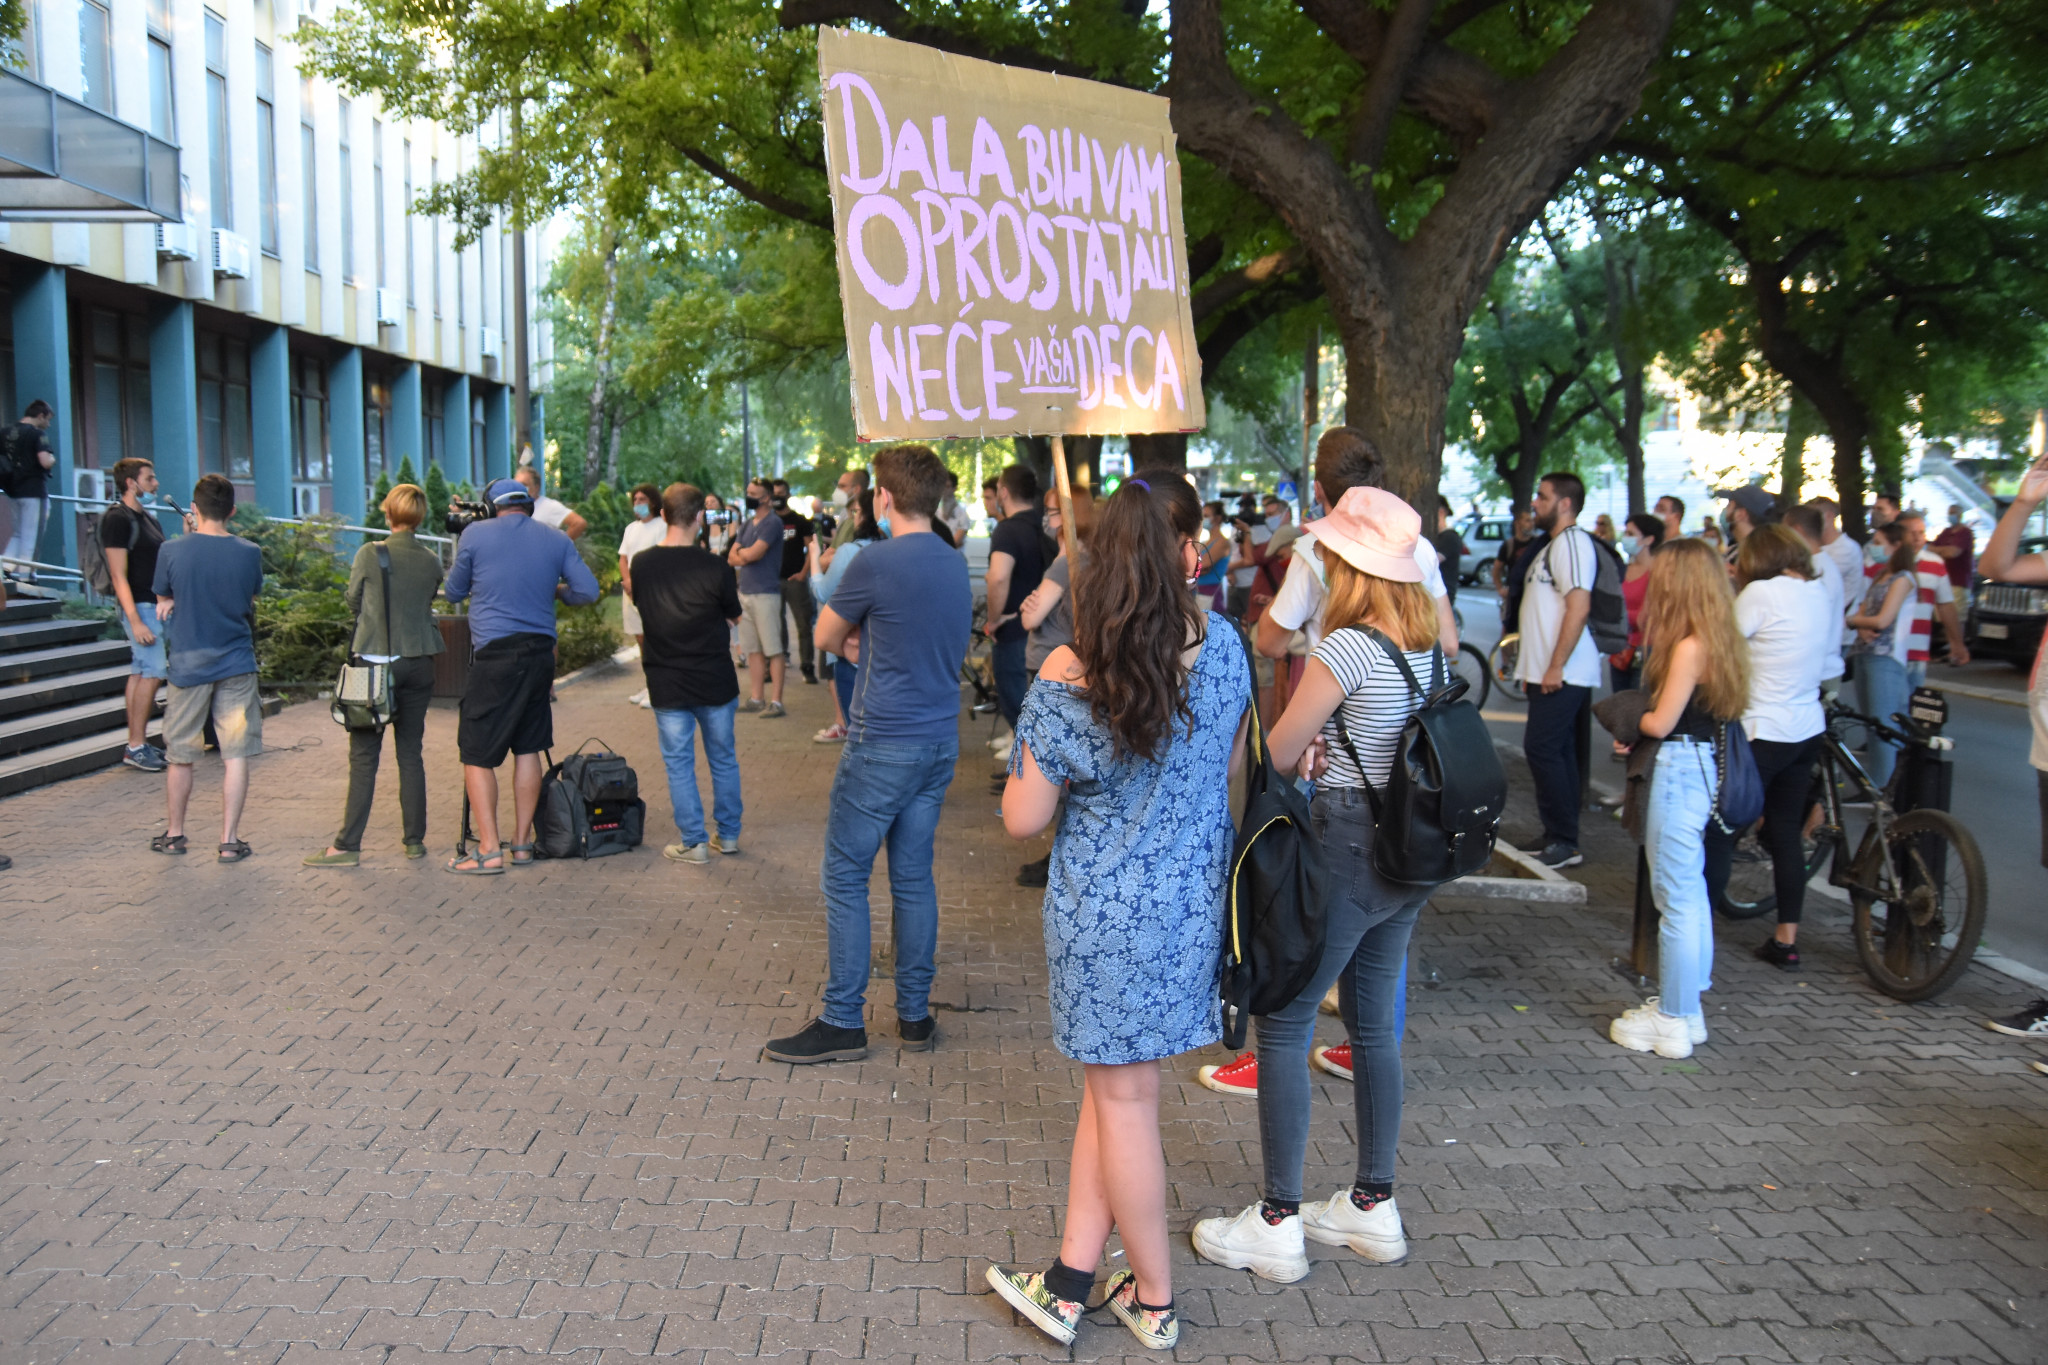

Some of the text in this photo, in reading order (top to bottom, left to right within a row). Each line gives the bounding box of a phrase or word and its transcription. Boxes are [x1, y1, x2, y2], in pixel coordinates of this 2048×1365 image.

[829, 72, 1168, 235] DALA BIH VAM
[847, 187, 1176, 323] OPROŠTAJ ALI
[868, 302, 1184, 421] NEĆE VAŠA DECA
